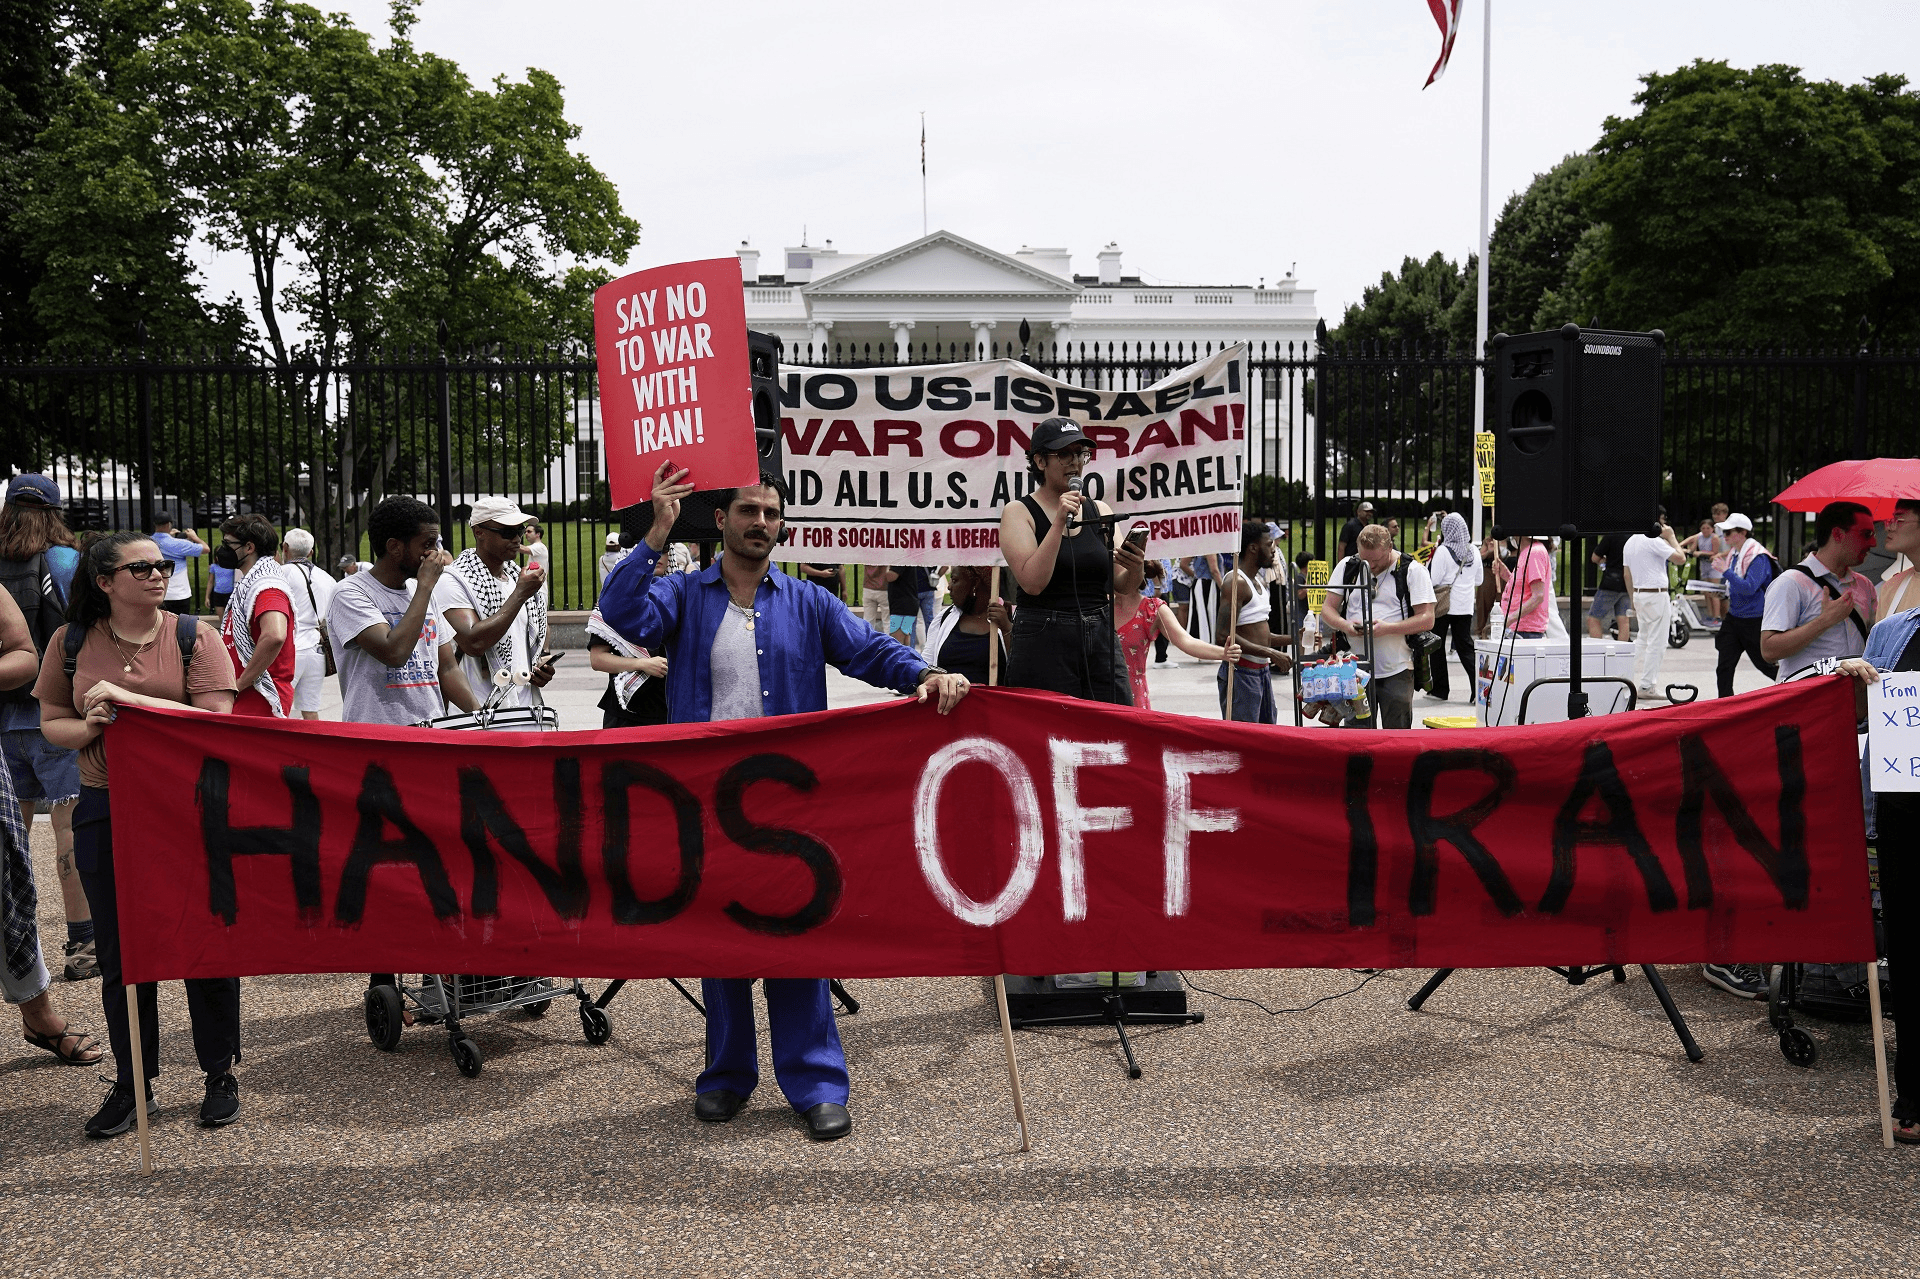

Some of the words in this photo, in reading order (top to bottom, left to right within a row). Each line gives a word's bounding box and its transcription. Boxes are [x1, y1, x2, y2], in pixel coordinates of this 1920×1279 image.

[616, 289, 658, 335] SAY
[666, 282, 707, 321] NO
[615, 335, 645, 376] TO
[651, 323, 715, 366] WAR
[1583, 344, 1623, 356] SOUNDBOKS
[632, 365, 698, 412] WITH
[874, 359, 1241, 421] US-ISRAELI
[633, 407, 705, 456] IRAN!
[1083, 403, 1246, 461] RAN!
[782, 470, 823, 506] ND
[834, 469, 899, 508] ALL
[908, 471, 979, 509] U.S.
[1084, 472, 1105, 502] O
[1116, 455, 1242, 503] ISRAEL!
[1483, 484, 1495, 494] EA
[802, 527, 833, 548] FOR
[838, 528, 925, 549] SOCIALISM
[931, 530, 942, 549] &
[947, 528, 1000, 549] LIBERA
[1131, 512, 1241, 541] PSLNATIONA
[1882, 677, 1918, 698] From
[197, 753, 843, 937] HANDS
[913, 734, 1244, 927] OFF
[1346, 723, 1810, 928] IRAN
